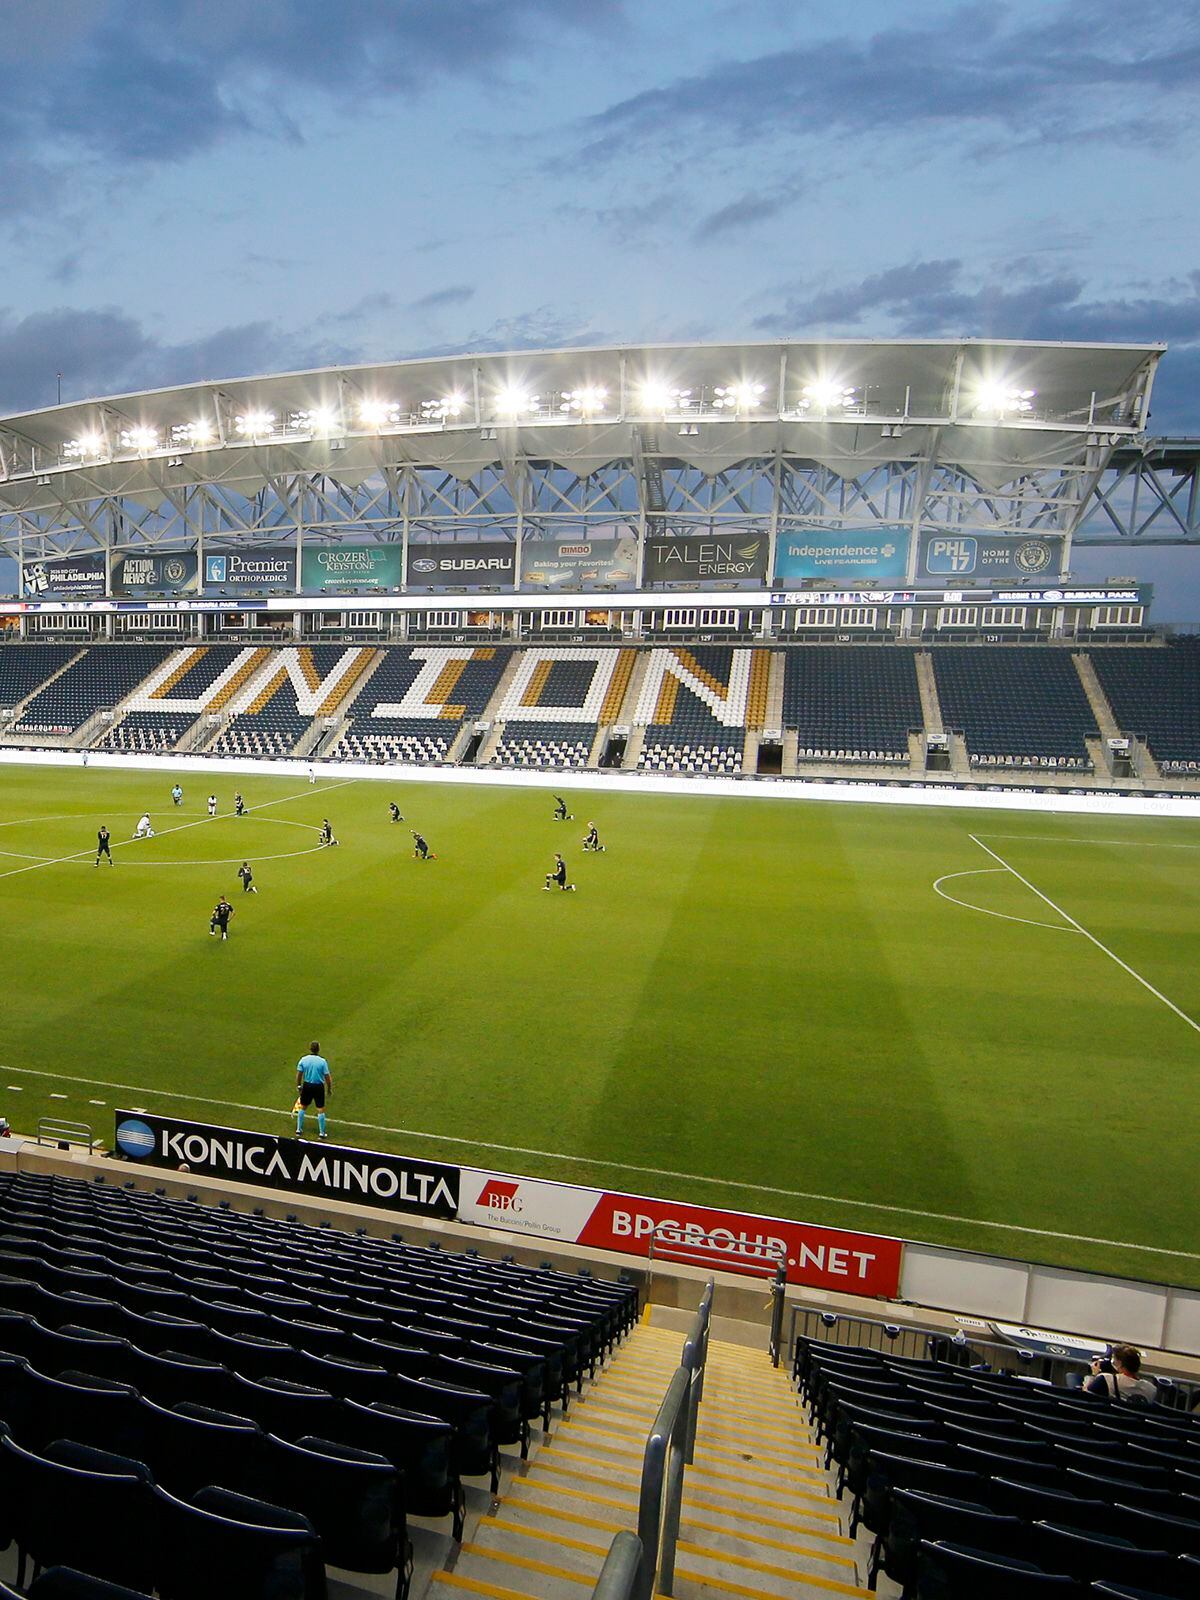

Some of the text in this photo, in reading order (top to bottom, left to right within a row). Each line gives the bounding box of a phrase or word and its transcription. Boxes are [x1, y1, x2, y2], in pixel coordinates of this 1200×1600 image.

[652, 543, 732, 563] TALEN
[788, 544, 878, 557] Independence
[933, 541, 970, 556] PHL
[229, 555, 290, 573] Premier
[317, 552, 366, 564] CROZER
[439, 558, 512, 571] SUBARU
[951, 556, 970, 571] 17
[123, 559, 154, 573] ACTION
[326, 561, 375, 571] KEYSTONE
[699, 561, 755, 575] ENERGY
[50, 572, 105, 582] PHILADELPHIA
[122, 572, 146, 585] NEWS
[229, 574, 288, 582] ORTHOPAEDICS
[1107, 591, 1136, 599] PARK
[122, 646, 771, 728] UNION
[1143, 801, 1173, 811] LOVE
[162, 1129, 457, 1210] KONICA MINOLTA
[488, 1192, 523, 1213] BPG
[488, 1213, 499, 1221] The
[542, 1223, 561, 1234] Group
[611, 1209, 877, 1279] BPGROUP.NET
